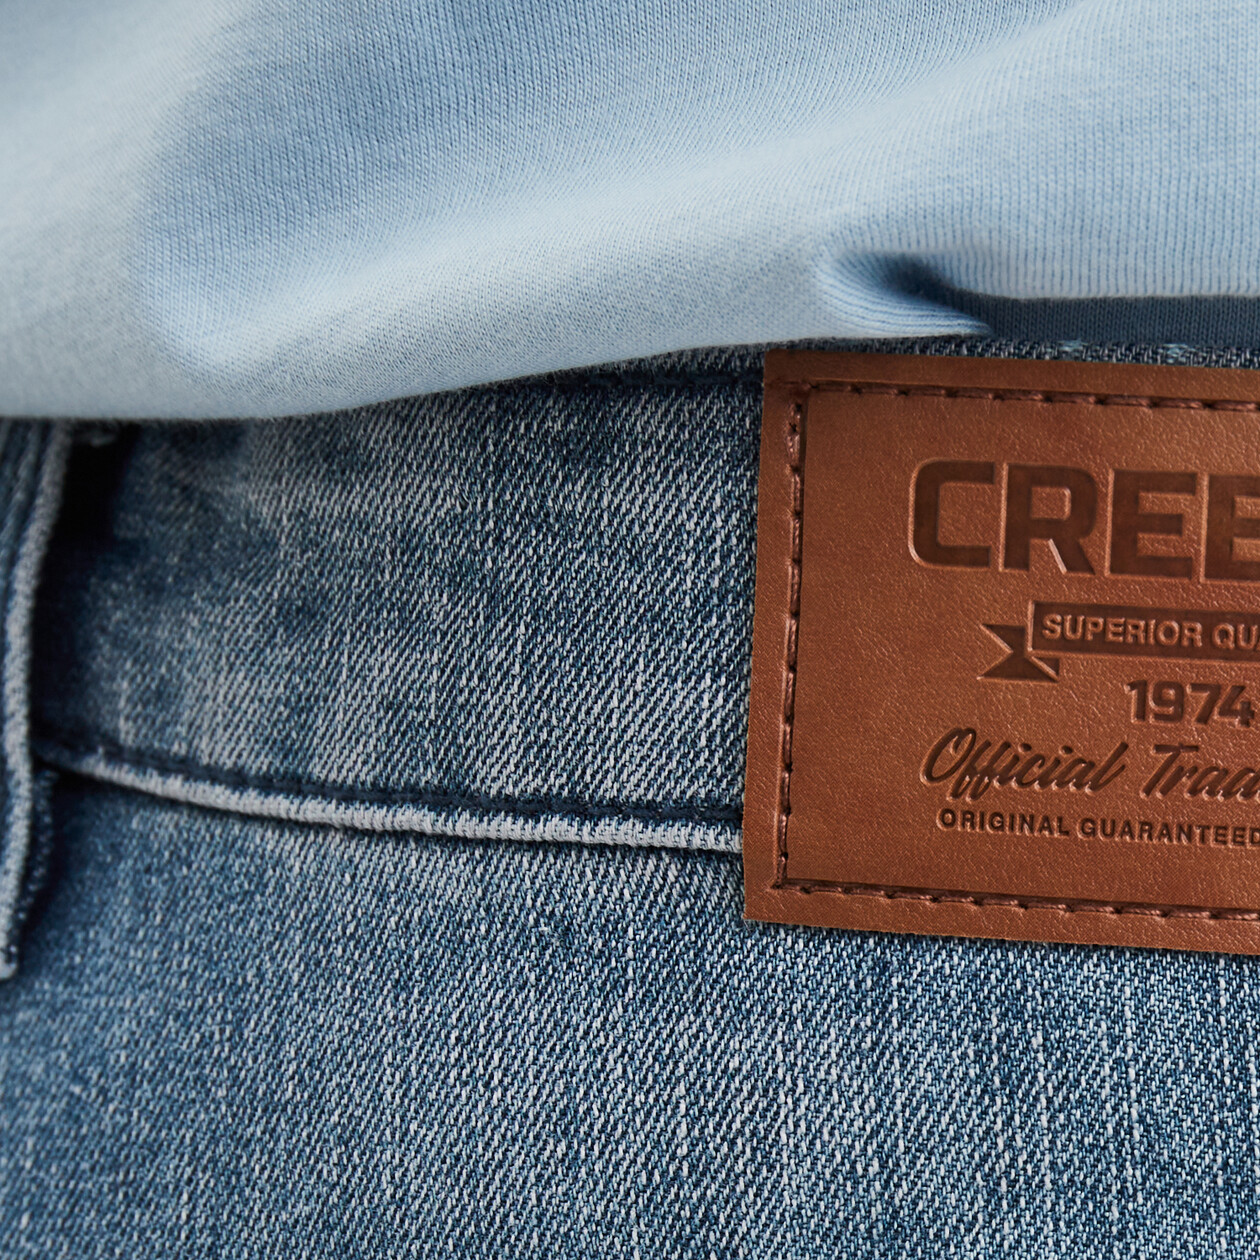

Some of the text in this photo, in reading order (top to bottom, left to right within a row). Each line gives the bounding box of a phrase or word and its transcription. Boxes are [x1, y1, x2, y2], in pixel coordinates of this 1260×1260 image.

[1041, 613, 1204, 649] SUPERIOR
[1124, 679, 1256, 727] 1974
[920, 727, 1129, 802] Official
[937, 808, 1070, 837] ORIGINAL
